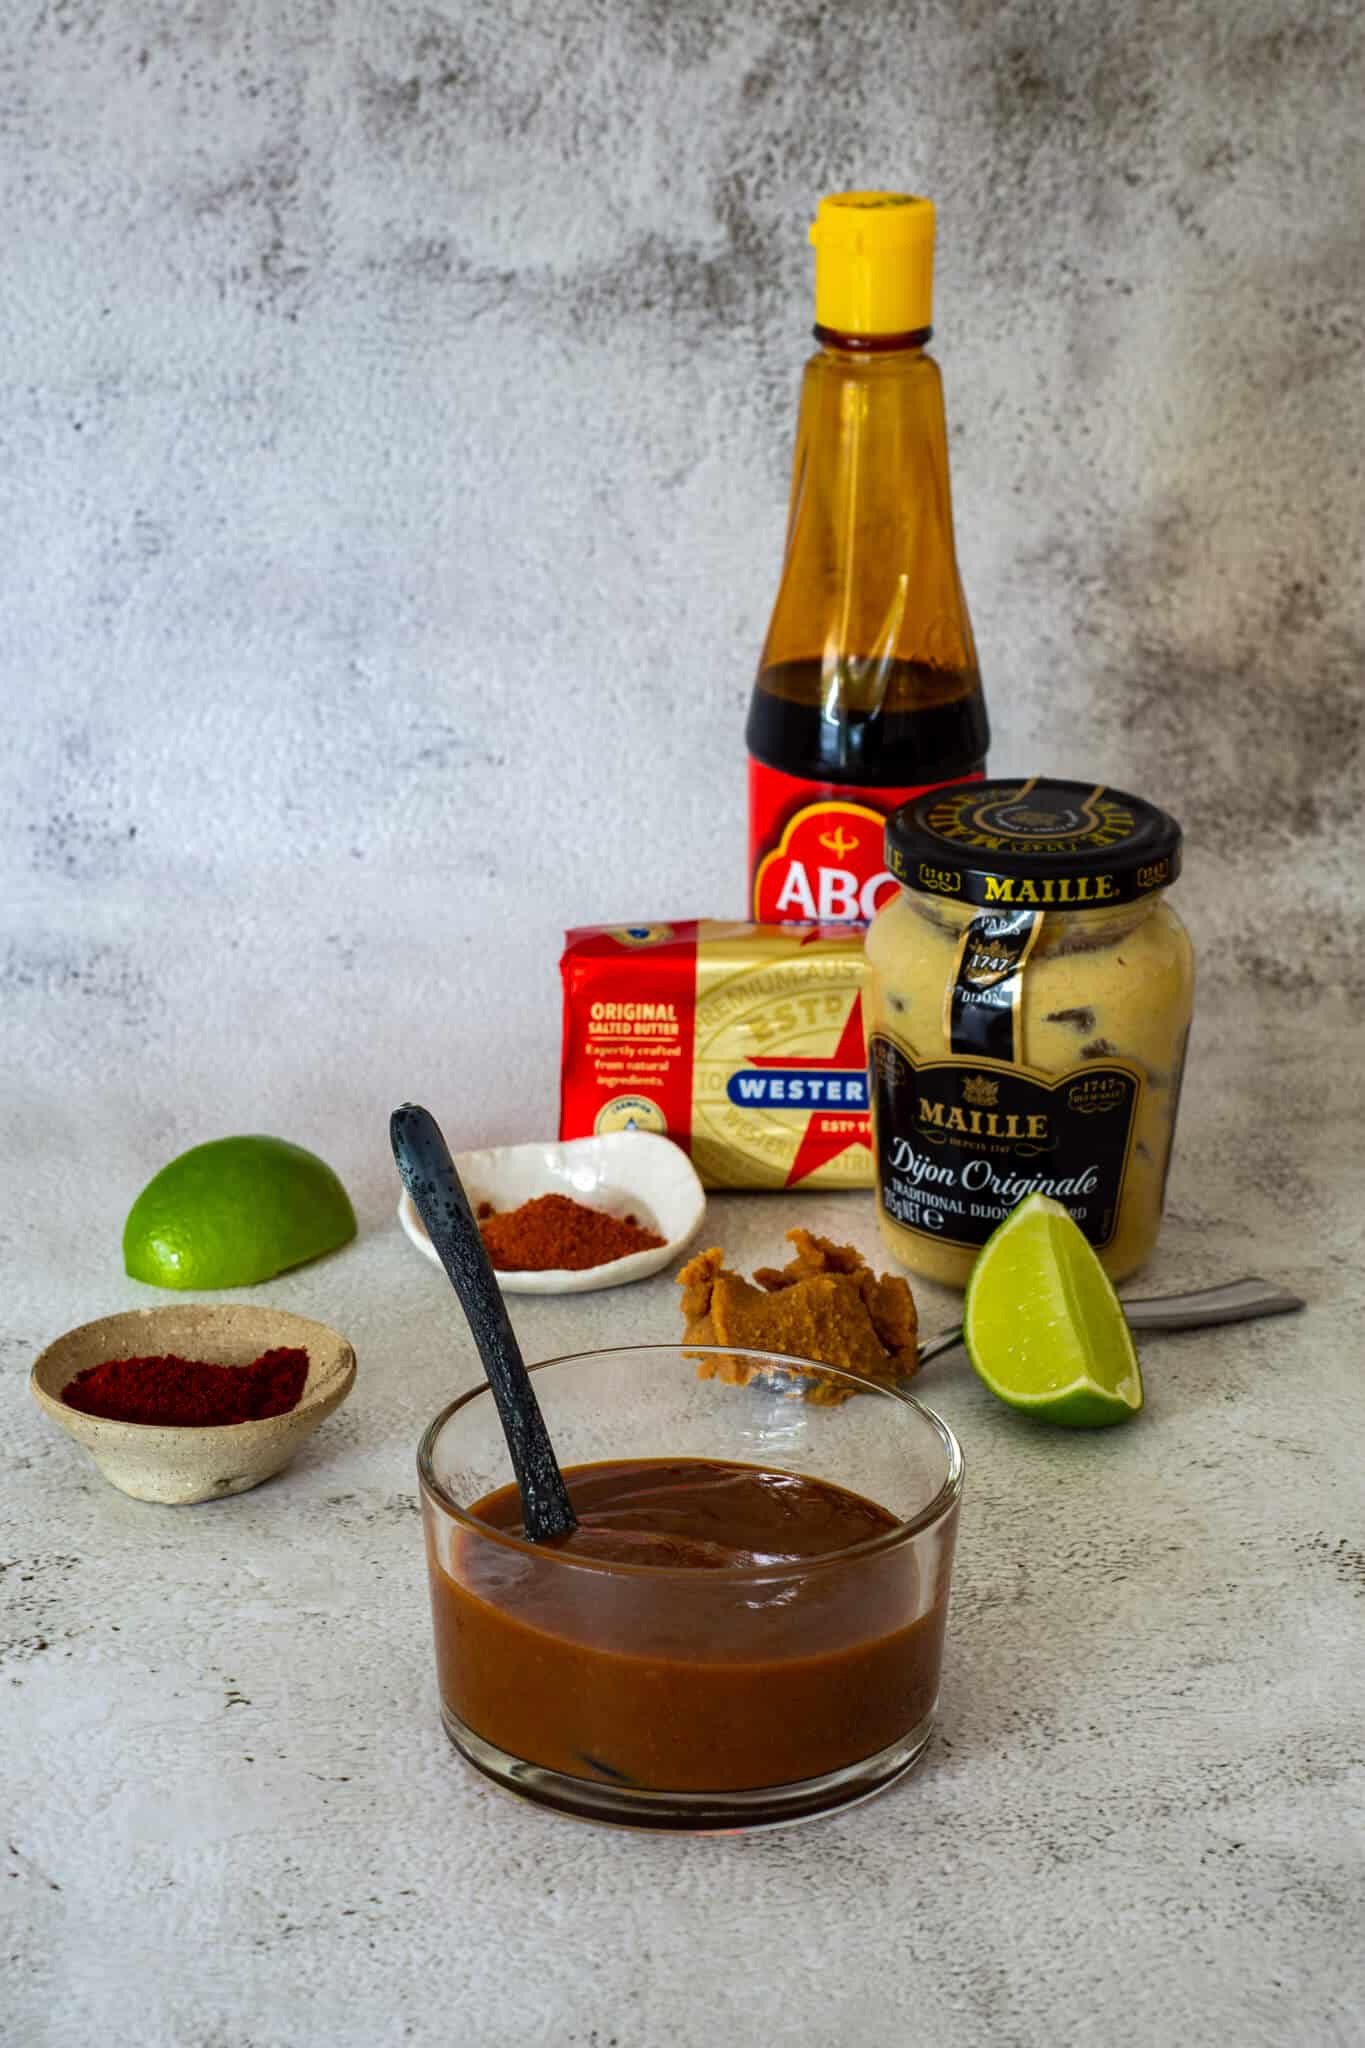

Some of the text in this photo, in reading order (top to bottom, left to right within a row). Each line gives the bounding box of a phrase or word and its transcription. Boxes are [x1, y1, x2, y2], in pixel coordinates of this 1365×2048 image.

[971, 954, 1009, 971] 1747
[590, 1002, 677, 1021] ORIGINAL
[588, 1022, 679, 1035] SALTED BUTTER
[585, 1043, 681, 1058] Expertly crafted
[594, 1059, 669, 1071] from natural
[738, 1079, 864, 1101] WESTER
[919, 1097, 1047, 1139] MAILLE
[888, 1136, 1099, 1206] Dijon Originale
[891, 1177, 967, 1215] TRADITIONAL
